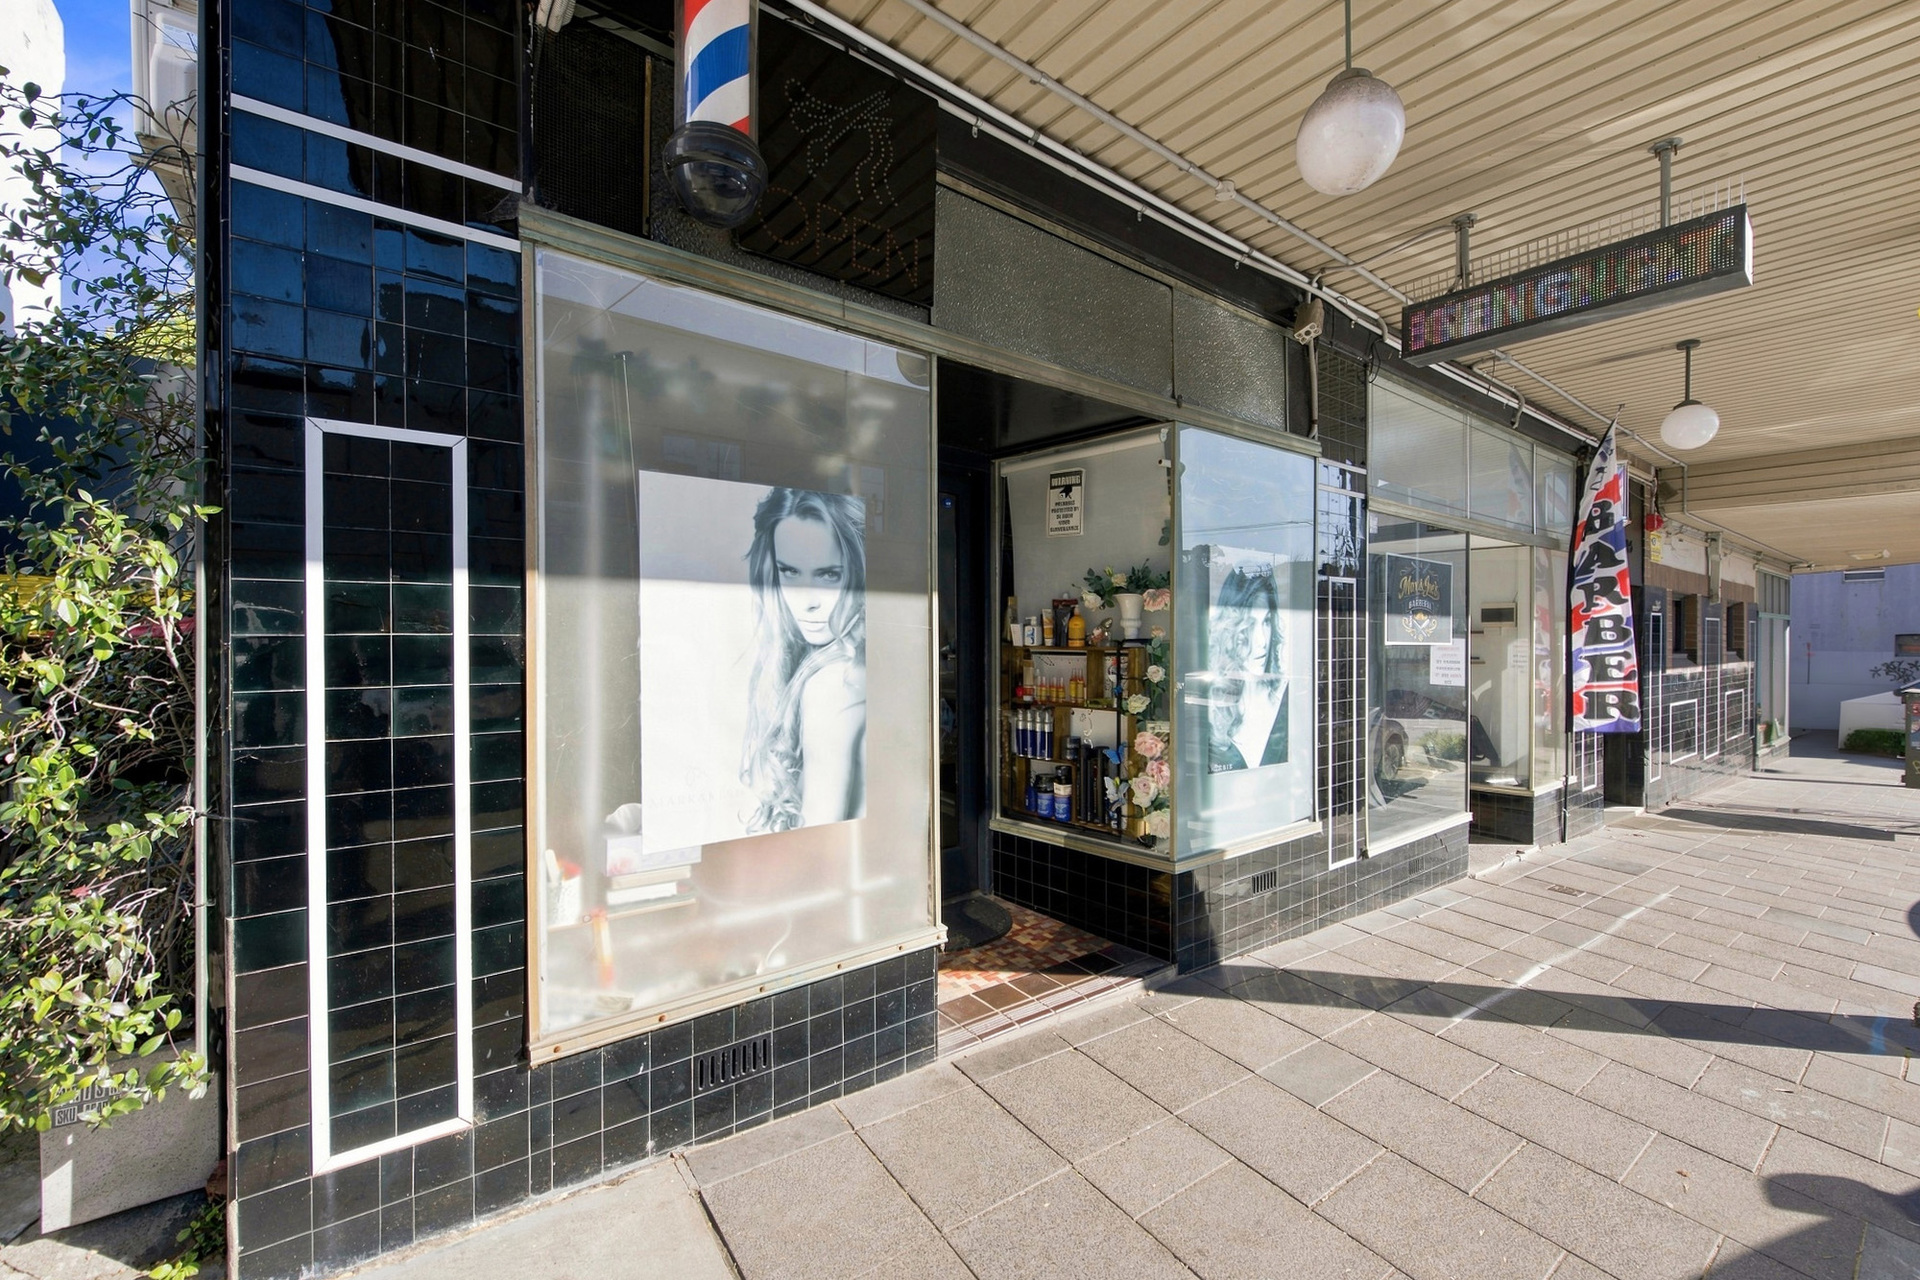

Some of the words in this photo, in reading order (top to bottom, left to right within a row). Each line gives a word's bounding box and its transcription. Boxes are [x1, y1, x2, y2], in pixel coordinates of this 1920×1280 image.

[757, 187, 920, 288] OPEN
[1051, 475, 1081, 487] WARNING
[1574, 498, 1642, 723] BARBER
[56, 1105, 78, 1127] SKU
